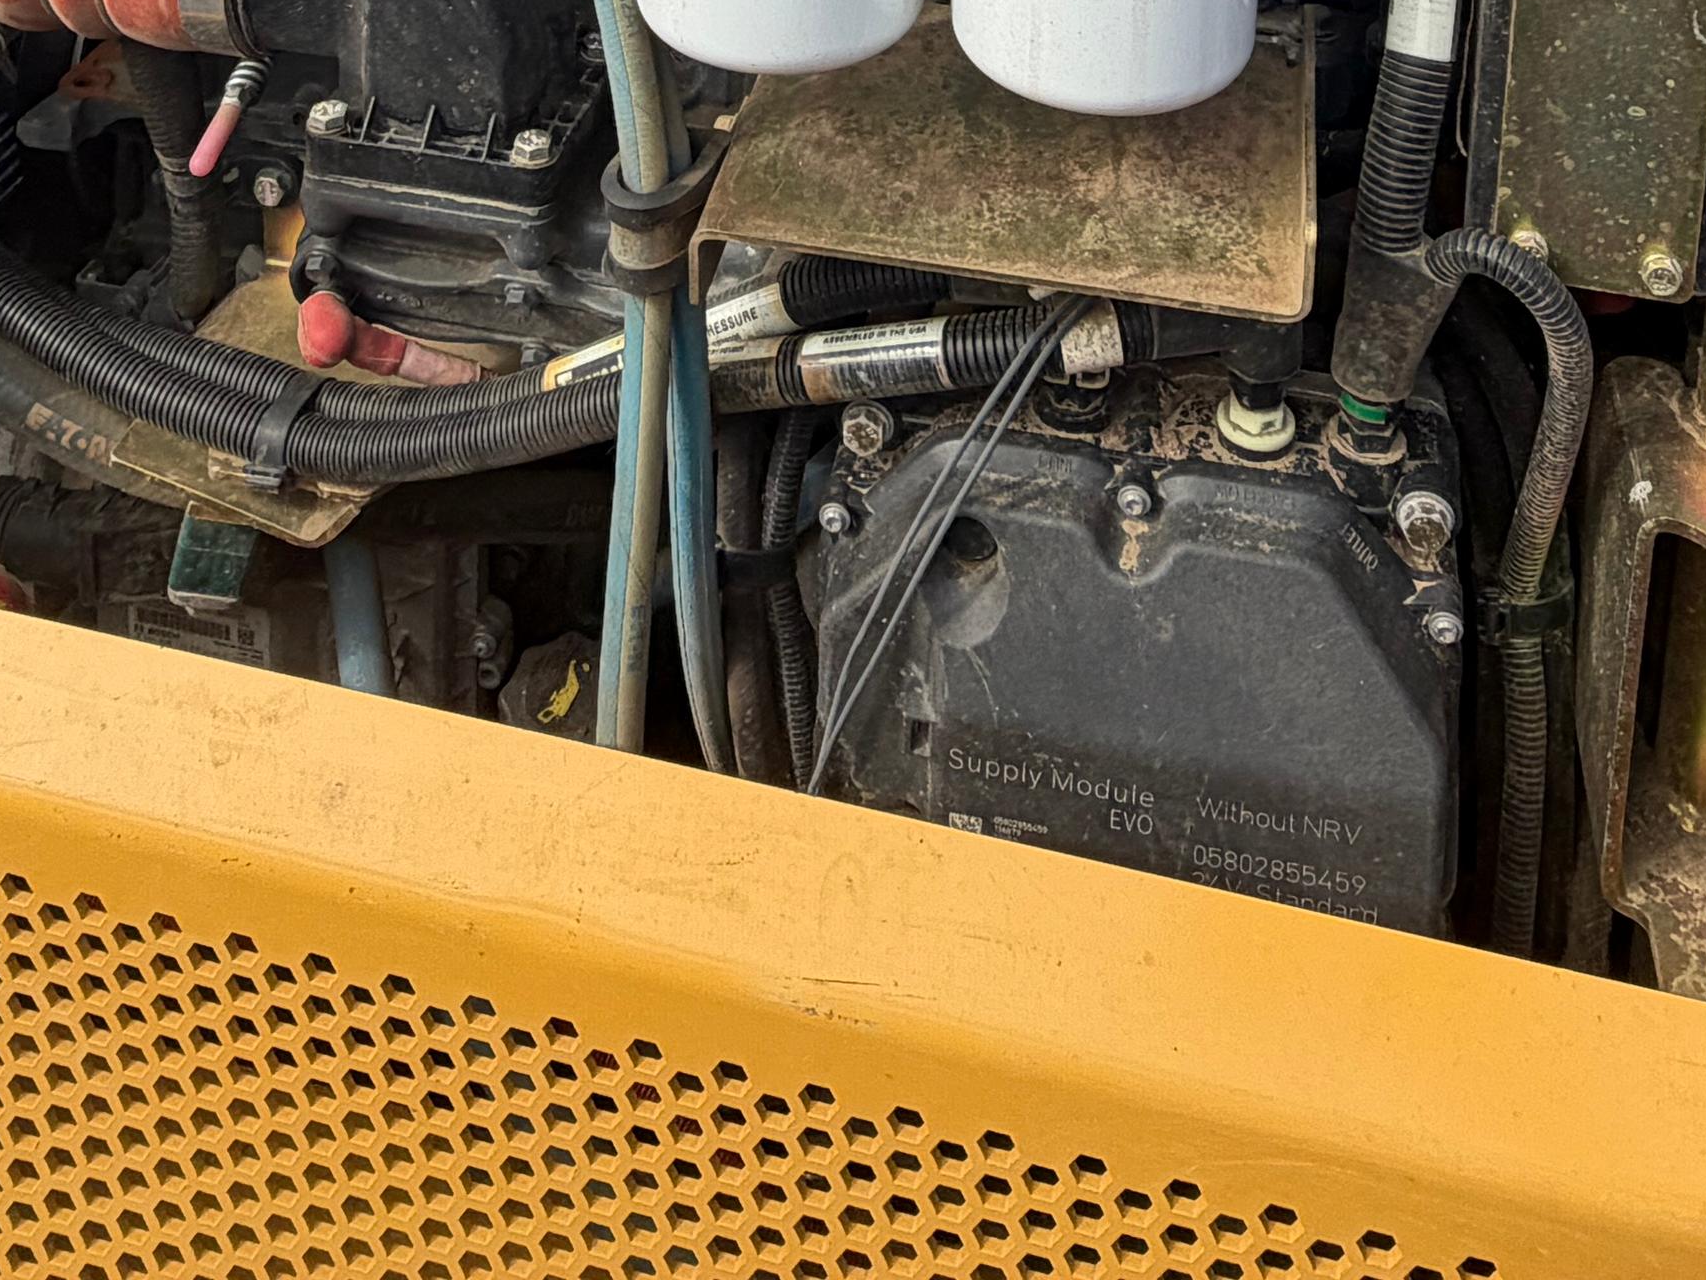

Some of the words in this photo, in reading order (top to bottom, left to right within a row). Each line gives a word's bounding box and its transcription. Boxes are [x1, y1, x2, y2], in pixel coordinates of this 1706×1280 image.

[706, 306, 759, 338] RESSURE
[822, 331, 876, 345] ASSEMBLED
[889, 328, 907, 338] THE
[909, 325, 928, 336] USA
[948, 747, 1043, 790] Supply
[1051, 767, 1156, 809] Module
[1109, 807, 1154, 836] EVO
[1196, 796, 1295, 833] Without
[1303, 815, 1363, 846] NRV
[1192, 844, 1367, 897] 05802855459
